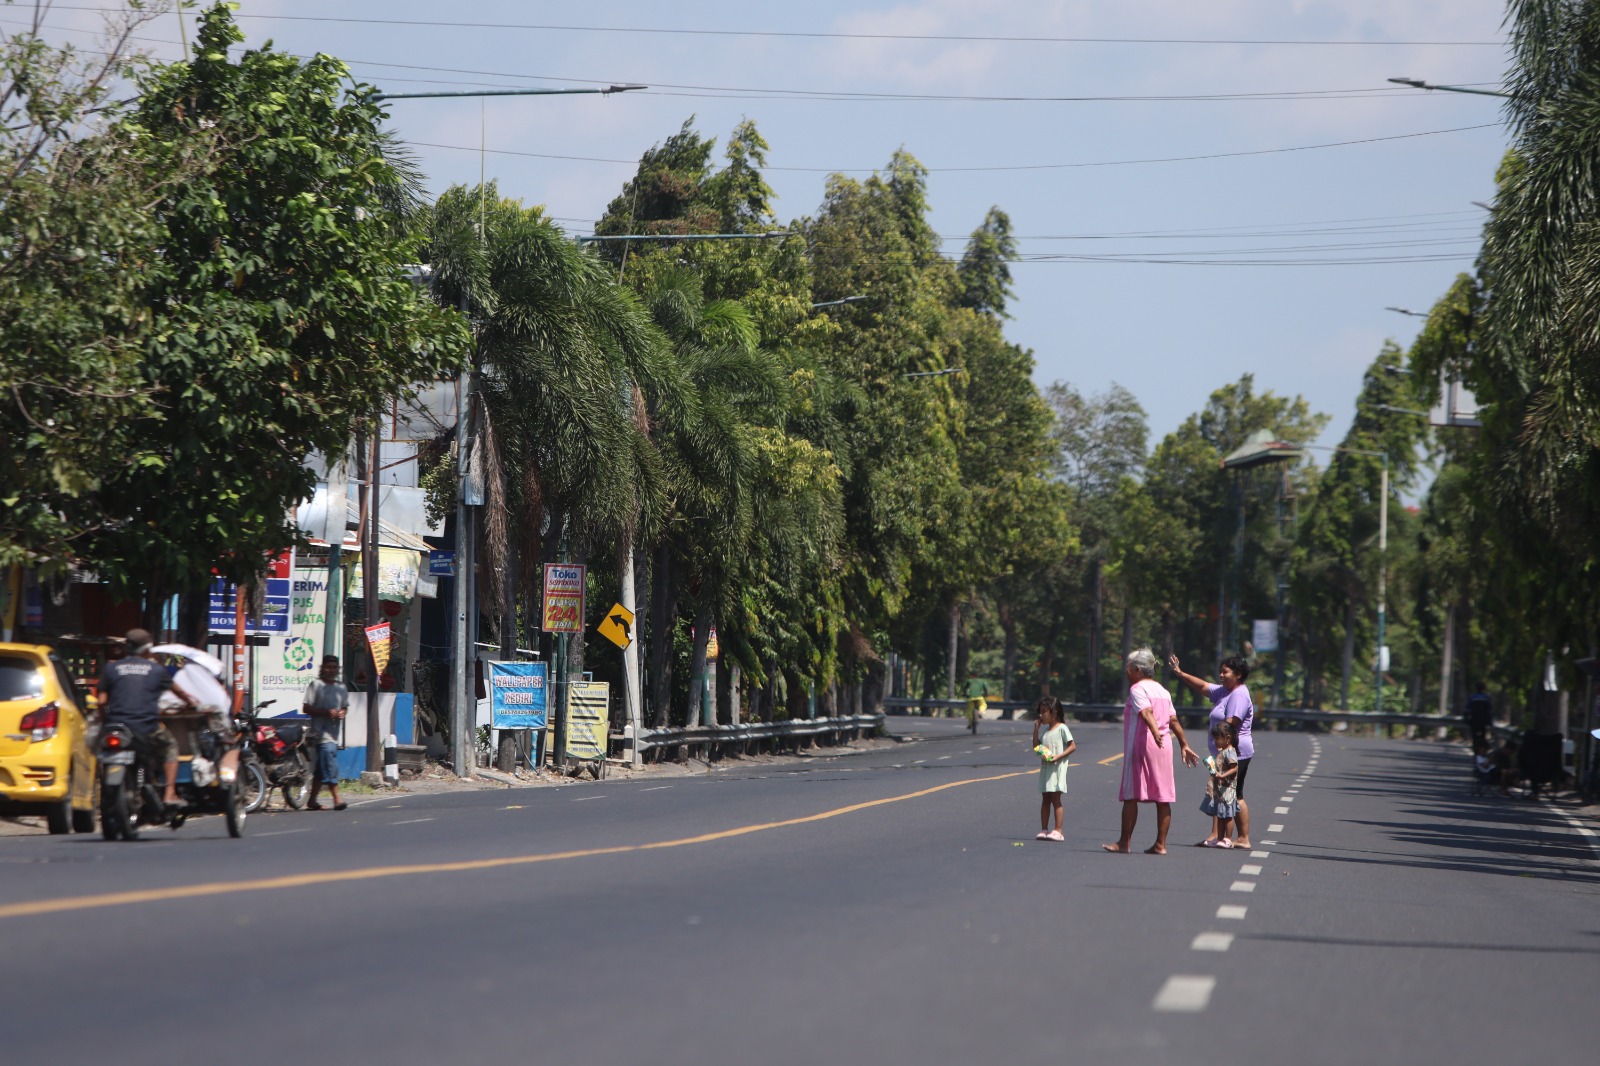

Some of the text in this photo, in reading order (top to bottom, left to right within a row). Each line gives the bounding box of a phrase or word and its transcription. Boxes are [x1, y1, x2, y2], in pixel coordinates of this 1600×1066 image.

[552, 569, 578, 579] Toko
[548, 599, 578, 607] BUKA
[548, 606, 578, 622] 24
[211, 617, 277, 627] HOM CRE
[262, 675, 284, 685] BPJS
[494, 675, 544, 688] WALLPAPER
[504, 692, 533, 704] KEDIRI
